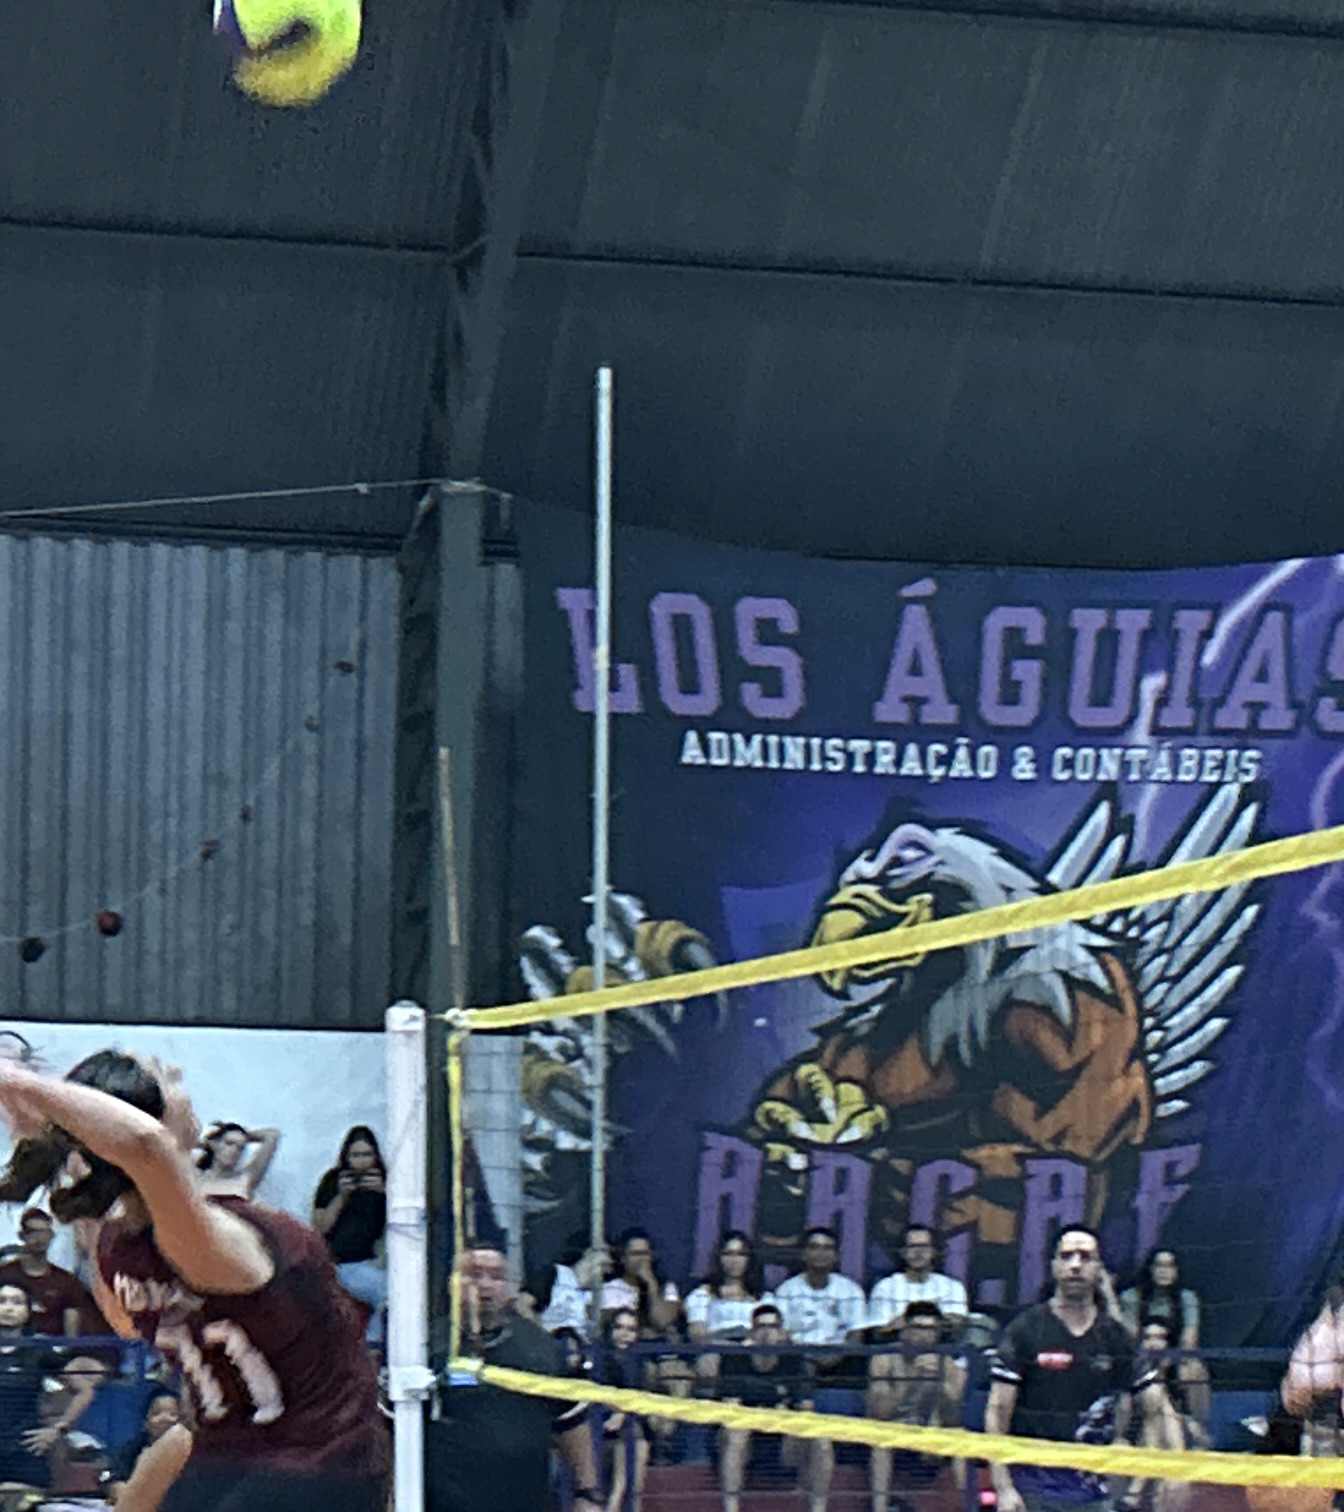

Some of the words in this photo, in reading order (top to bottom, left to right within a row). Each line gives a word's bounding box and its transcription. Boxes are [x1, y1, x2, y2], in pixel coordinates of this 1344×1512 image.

[556, 587, 805, 720] LOS
[680, 729, 998, 783] ADMINISTRAÇÃO
[1011, 745, 1038, 780] &
[1051, 741, 1262, 783] CONTÁBEIS
[155, 1318, 285, 1424] 11
